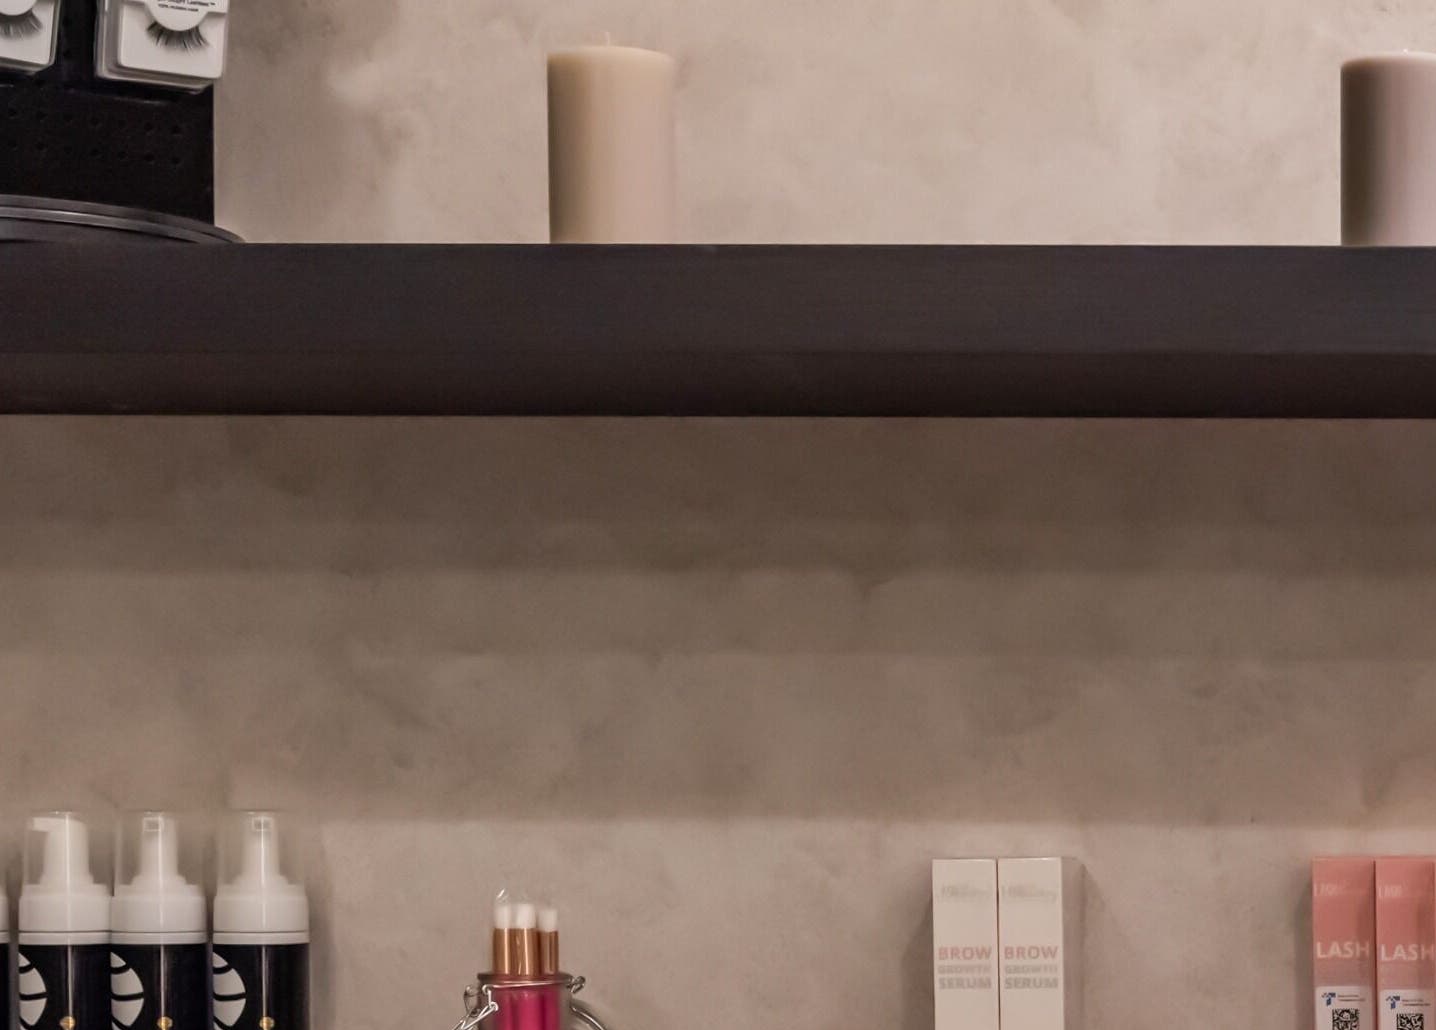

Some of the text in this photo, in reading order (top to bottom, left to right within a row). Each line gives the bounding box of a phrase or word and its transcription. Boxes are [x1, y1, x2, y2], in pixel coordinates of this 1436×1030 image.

[938, 946, 992, 960] BROW
[1004, 946, 1058, 959] BROW
[1316, 941, 1370, 960] LASH
[1380, 944, 1434, 962] LASH
[939, 978, 992, 989] SERUM
[1005, 977, 1058, 989] SERUM
